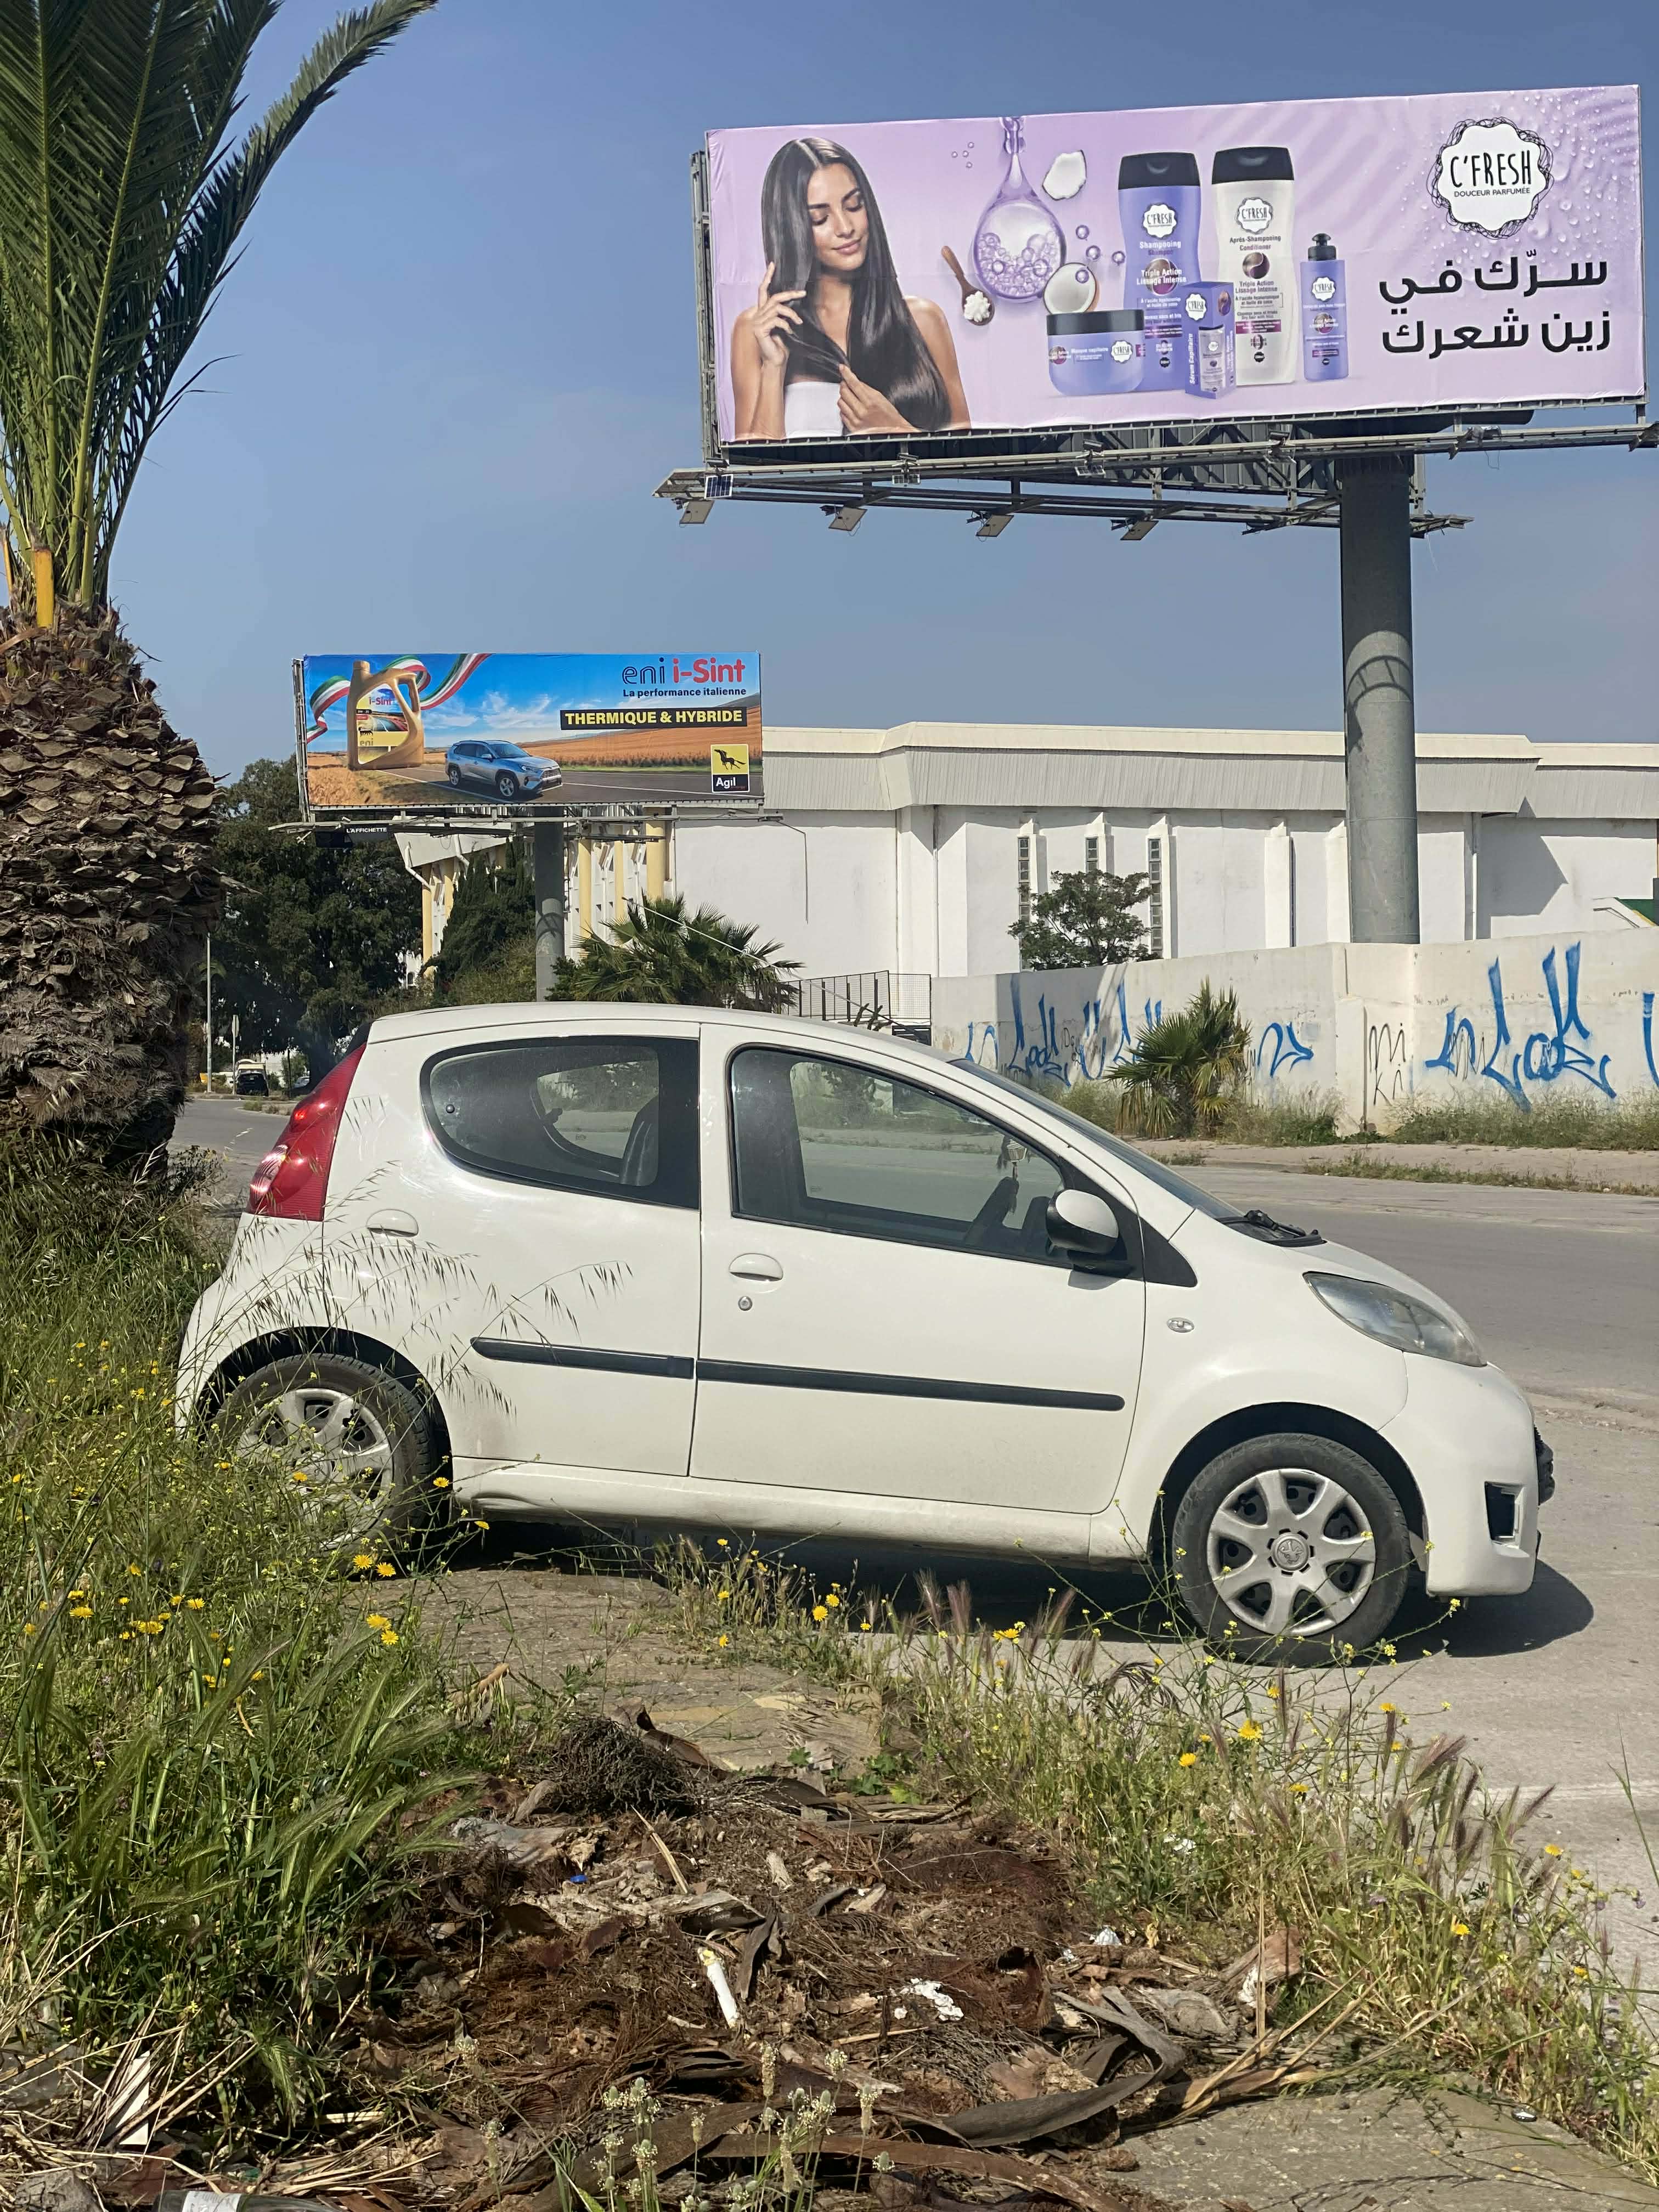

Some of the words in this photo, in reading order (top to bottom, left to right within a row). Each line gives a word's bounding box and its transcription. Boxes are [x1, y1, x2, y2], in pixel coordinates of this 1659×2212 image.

[1451, 150, 1531, 188] C'FRESH
[1492, 187, 1531, 195] PARFUMÉE
[1147, 212, 1172, 224] C'FRESH
[1242, 207, 1267, 219] C'FRESH
[1139, 241, 1181, 249] Shampooing
[1379, 259, 1463, 315] في
[1382, 307, 1530, 359] شعرك
[1541, 311, 1610, 353] زين
[622, 657, 665, 684] eni
[673, 657, 746, 684] i-Sint
[623, 689, 635, 697] La
[637, 689, 701, 698] performance
[703, 687, 747, 696] italienne
[565, 711, 657, 725] THERMIQUE
[660, 711, 673, 723] &
[676, 710, 742, 723] HYBRIDE
[715, 777, 736, 789] Agil
